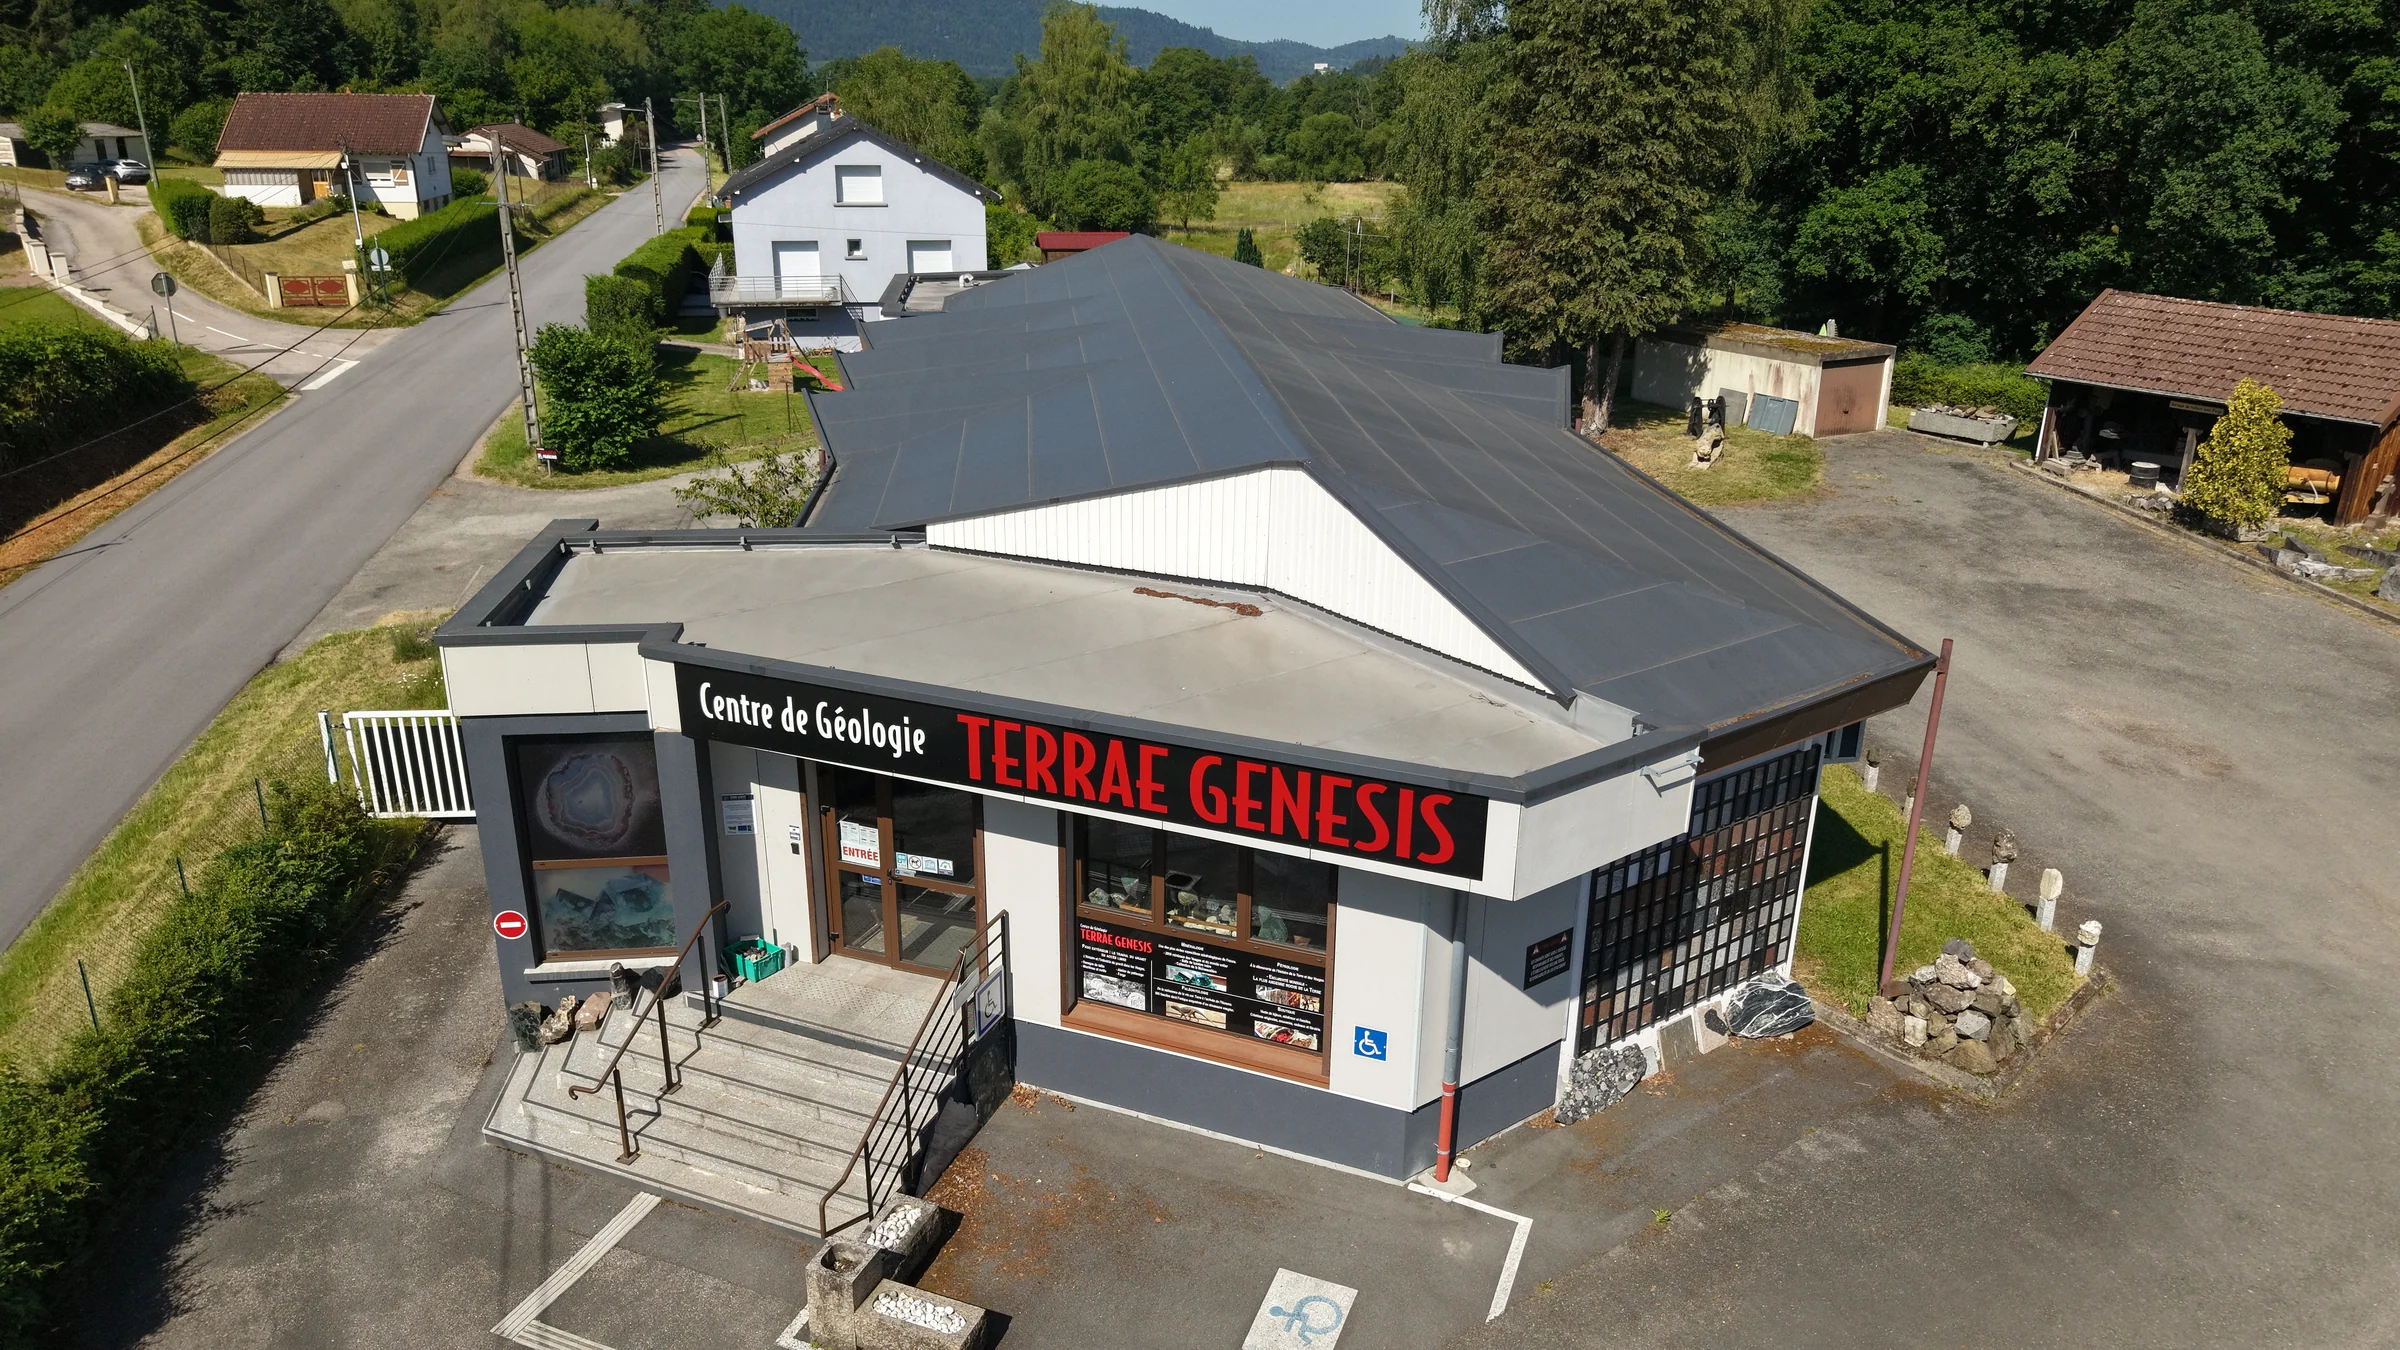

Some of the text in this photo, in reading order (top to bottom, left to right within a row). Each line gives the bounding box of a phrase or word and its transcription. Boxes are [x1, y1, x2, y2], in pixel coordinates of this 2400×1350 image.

[699, 682, 926, 759] Centre de Géologie
[956, 713, 1455, 865] TERRAE GENESIS
[842, 846, 879, 862] ENTRÉE
[1080, 928, 1113, 945] TERRAE
[1115, 935, 1153, 954] GENESIS
